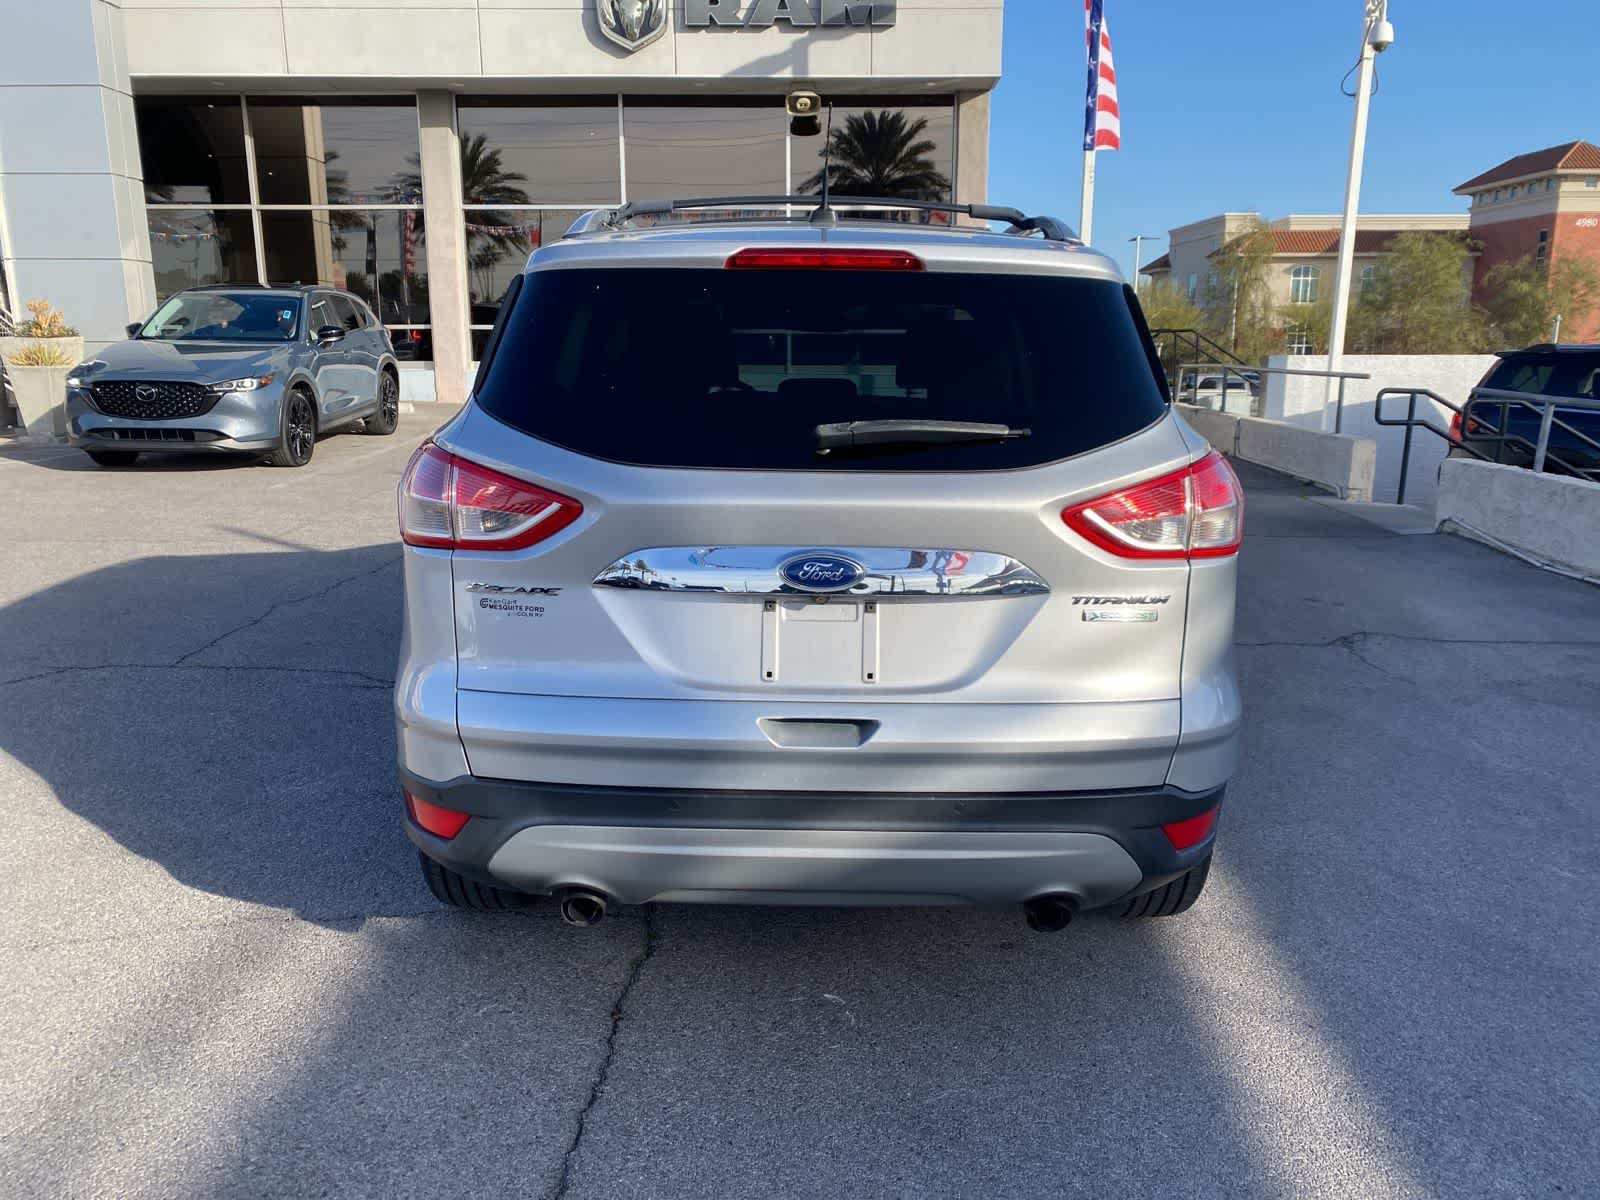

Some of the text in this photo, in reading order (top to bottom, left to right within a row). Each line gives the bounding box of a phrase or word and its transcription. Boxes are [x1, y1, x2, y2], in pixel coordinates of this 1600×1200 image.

[684, 0, 896, 26] RAM
[798, 561, 844, 581] Ford
[1072, 595, 1170, 605] TITANIUM
[489, 603, 545, 613] MESQUITE FORD
